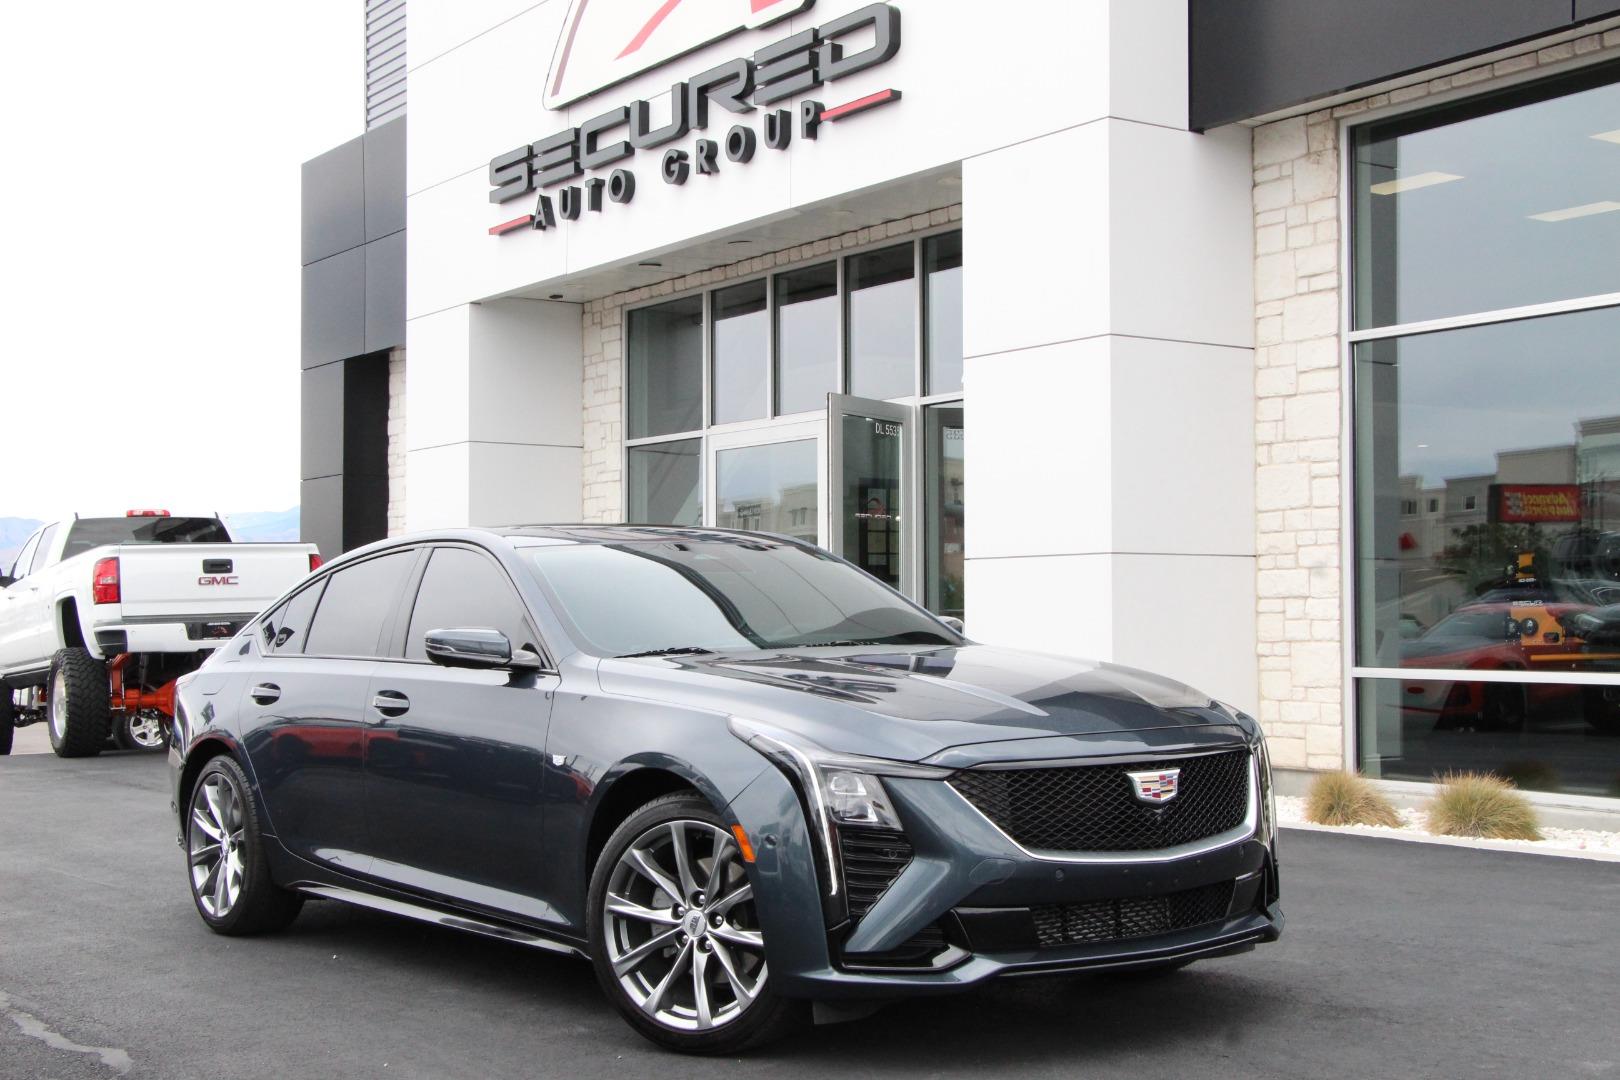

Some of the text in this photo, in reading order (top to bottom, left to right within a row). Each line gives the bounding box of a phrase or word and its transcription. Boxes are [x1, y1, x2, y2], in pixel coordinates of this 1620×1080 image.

[489, 3, 902, 205] SECURED
[532, 100, 825, 231] AUTO GROUP
[875, 422, 885, 435] DL
[198, 576, 239, 586] GMC
